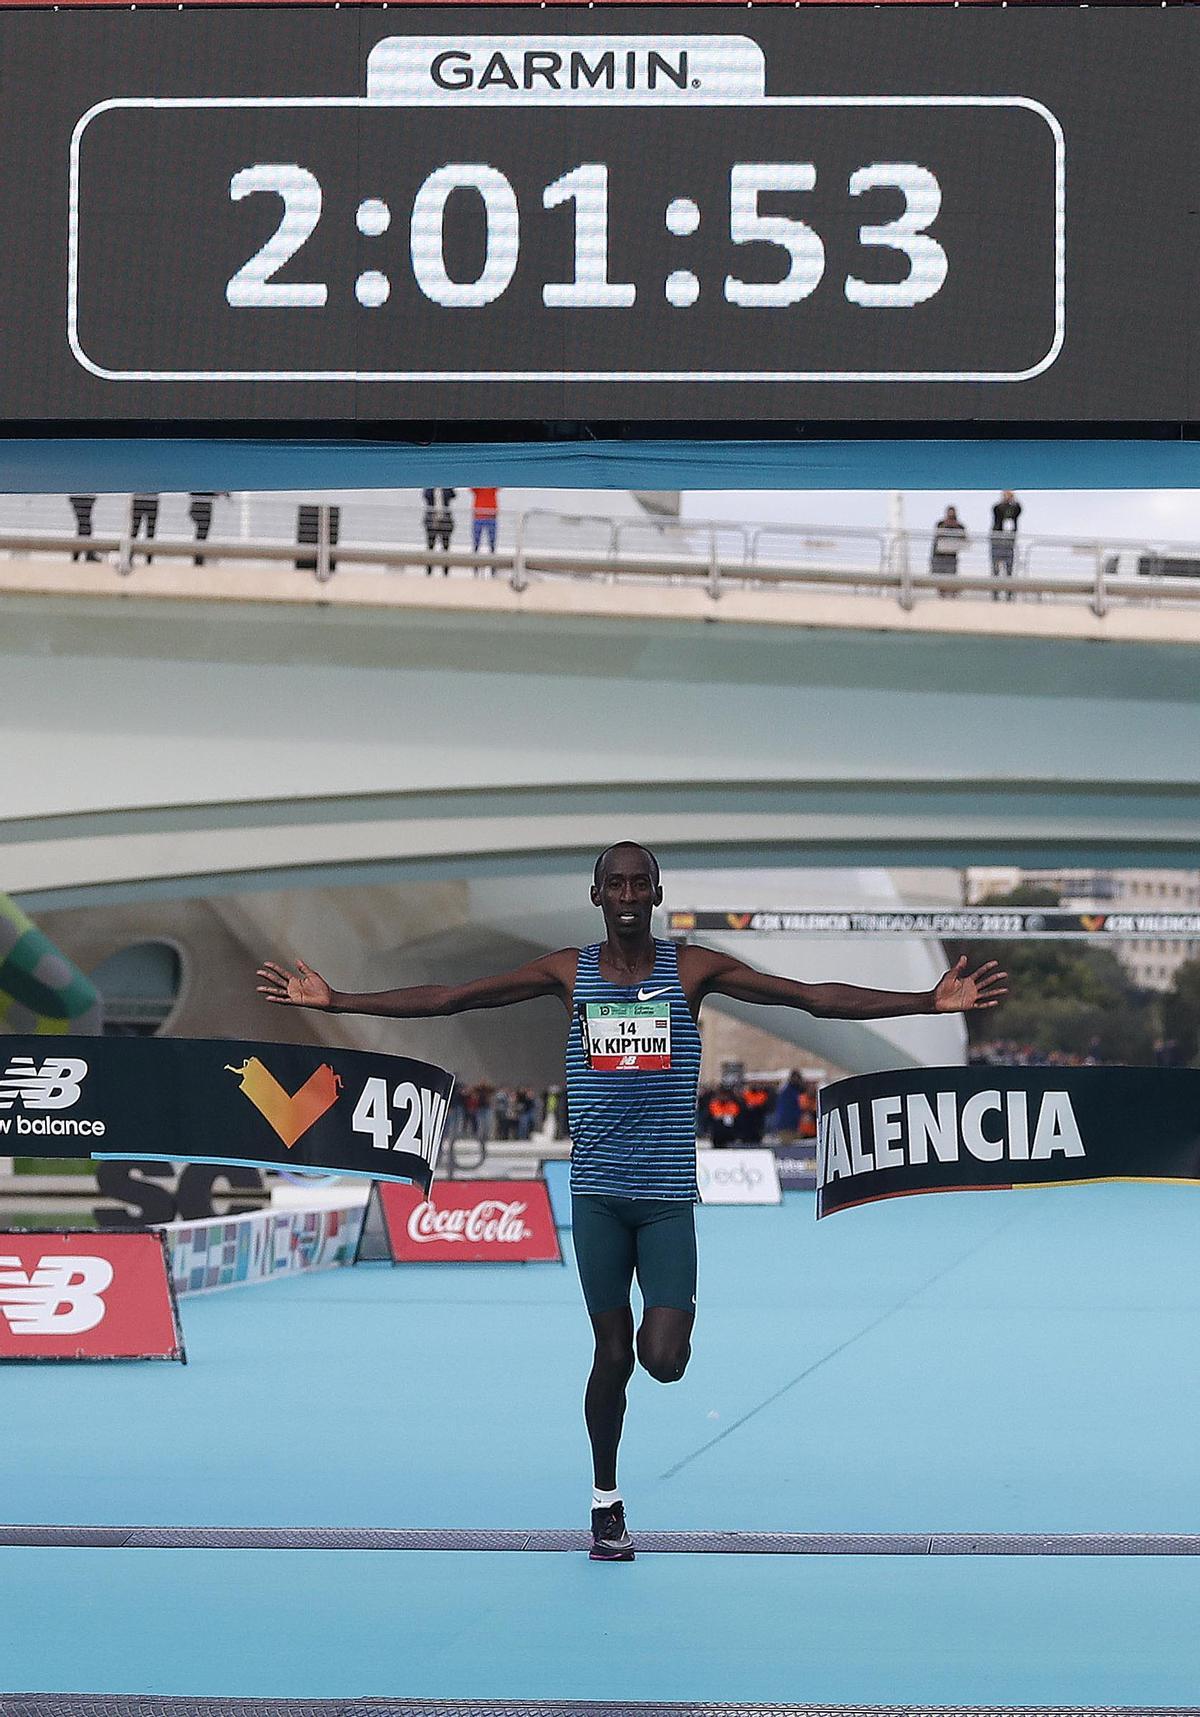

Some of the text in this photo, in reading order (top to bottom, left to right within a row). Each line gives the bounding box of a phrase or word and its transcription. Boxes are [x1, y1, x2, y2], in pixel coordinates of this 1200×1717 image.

[430, 50, 689, 90] GARMIN
[225, 162, 950, 309] 2:01:53
[618, 1021, 637, 1036] 14
[592, 1037, 667, 1054] K KIPTUM
[16, 1114, 105, 1136] balance
[407, 1200, 527, 1243] Coca-Cola
